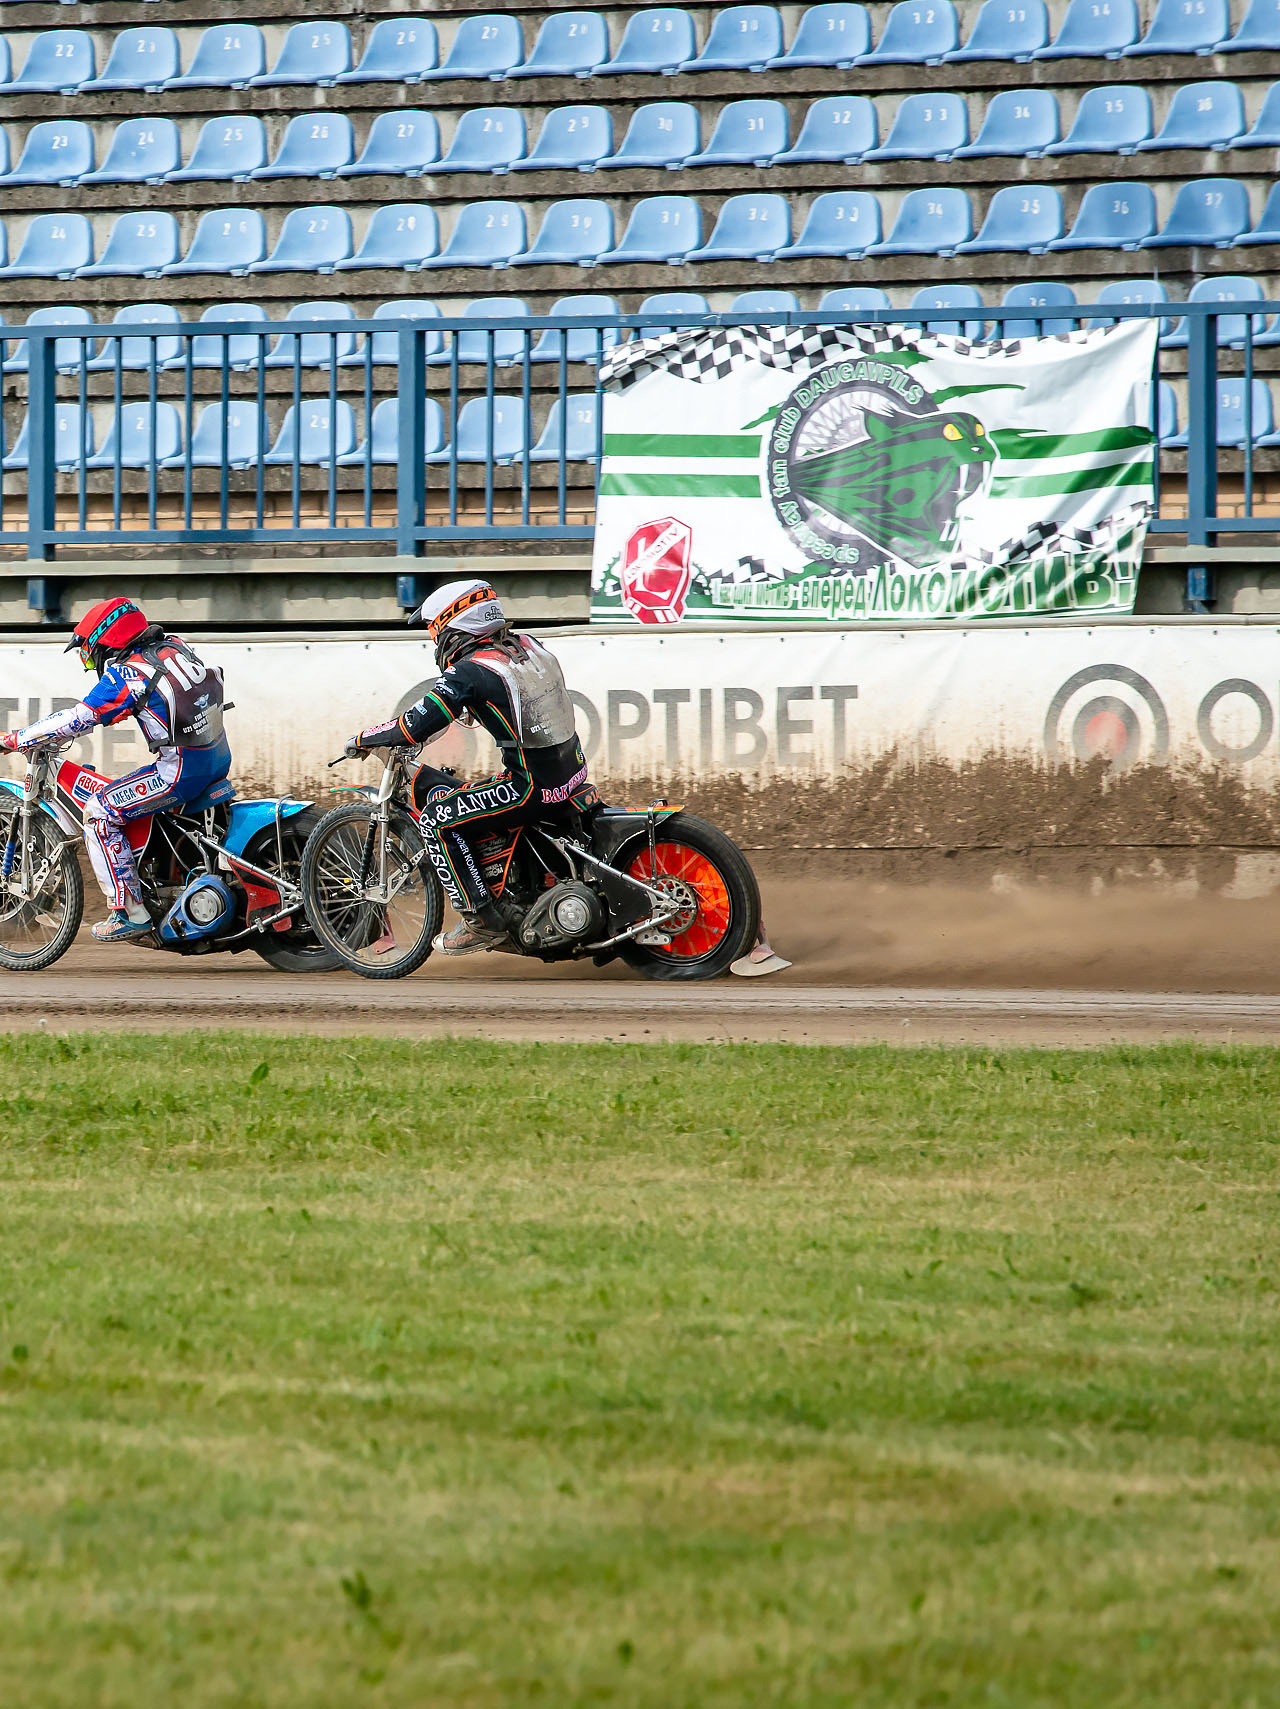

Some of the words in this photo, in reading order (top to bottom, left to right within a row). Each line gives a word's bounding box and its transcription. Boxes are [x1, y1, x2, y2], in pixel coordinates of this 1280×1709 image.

[773, 406, 802, 454] club
[793, 361, 925, 410] DAUGAVPILS
[111, 787, 137, 806] MEGA
[463, 854, 488, 898] KOMMUNE
